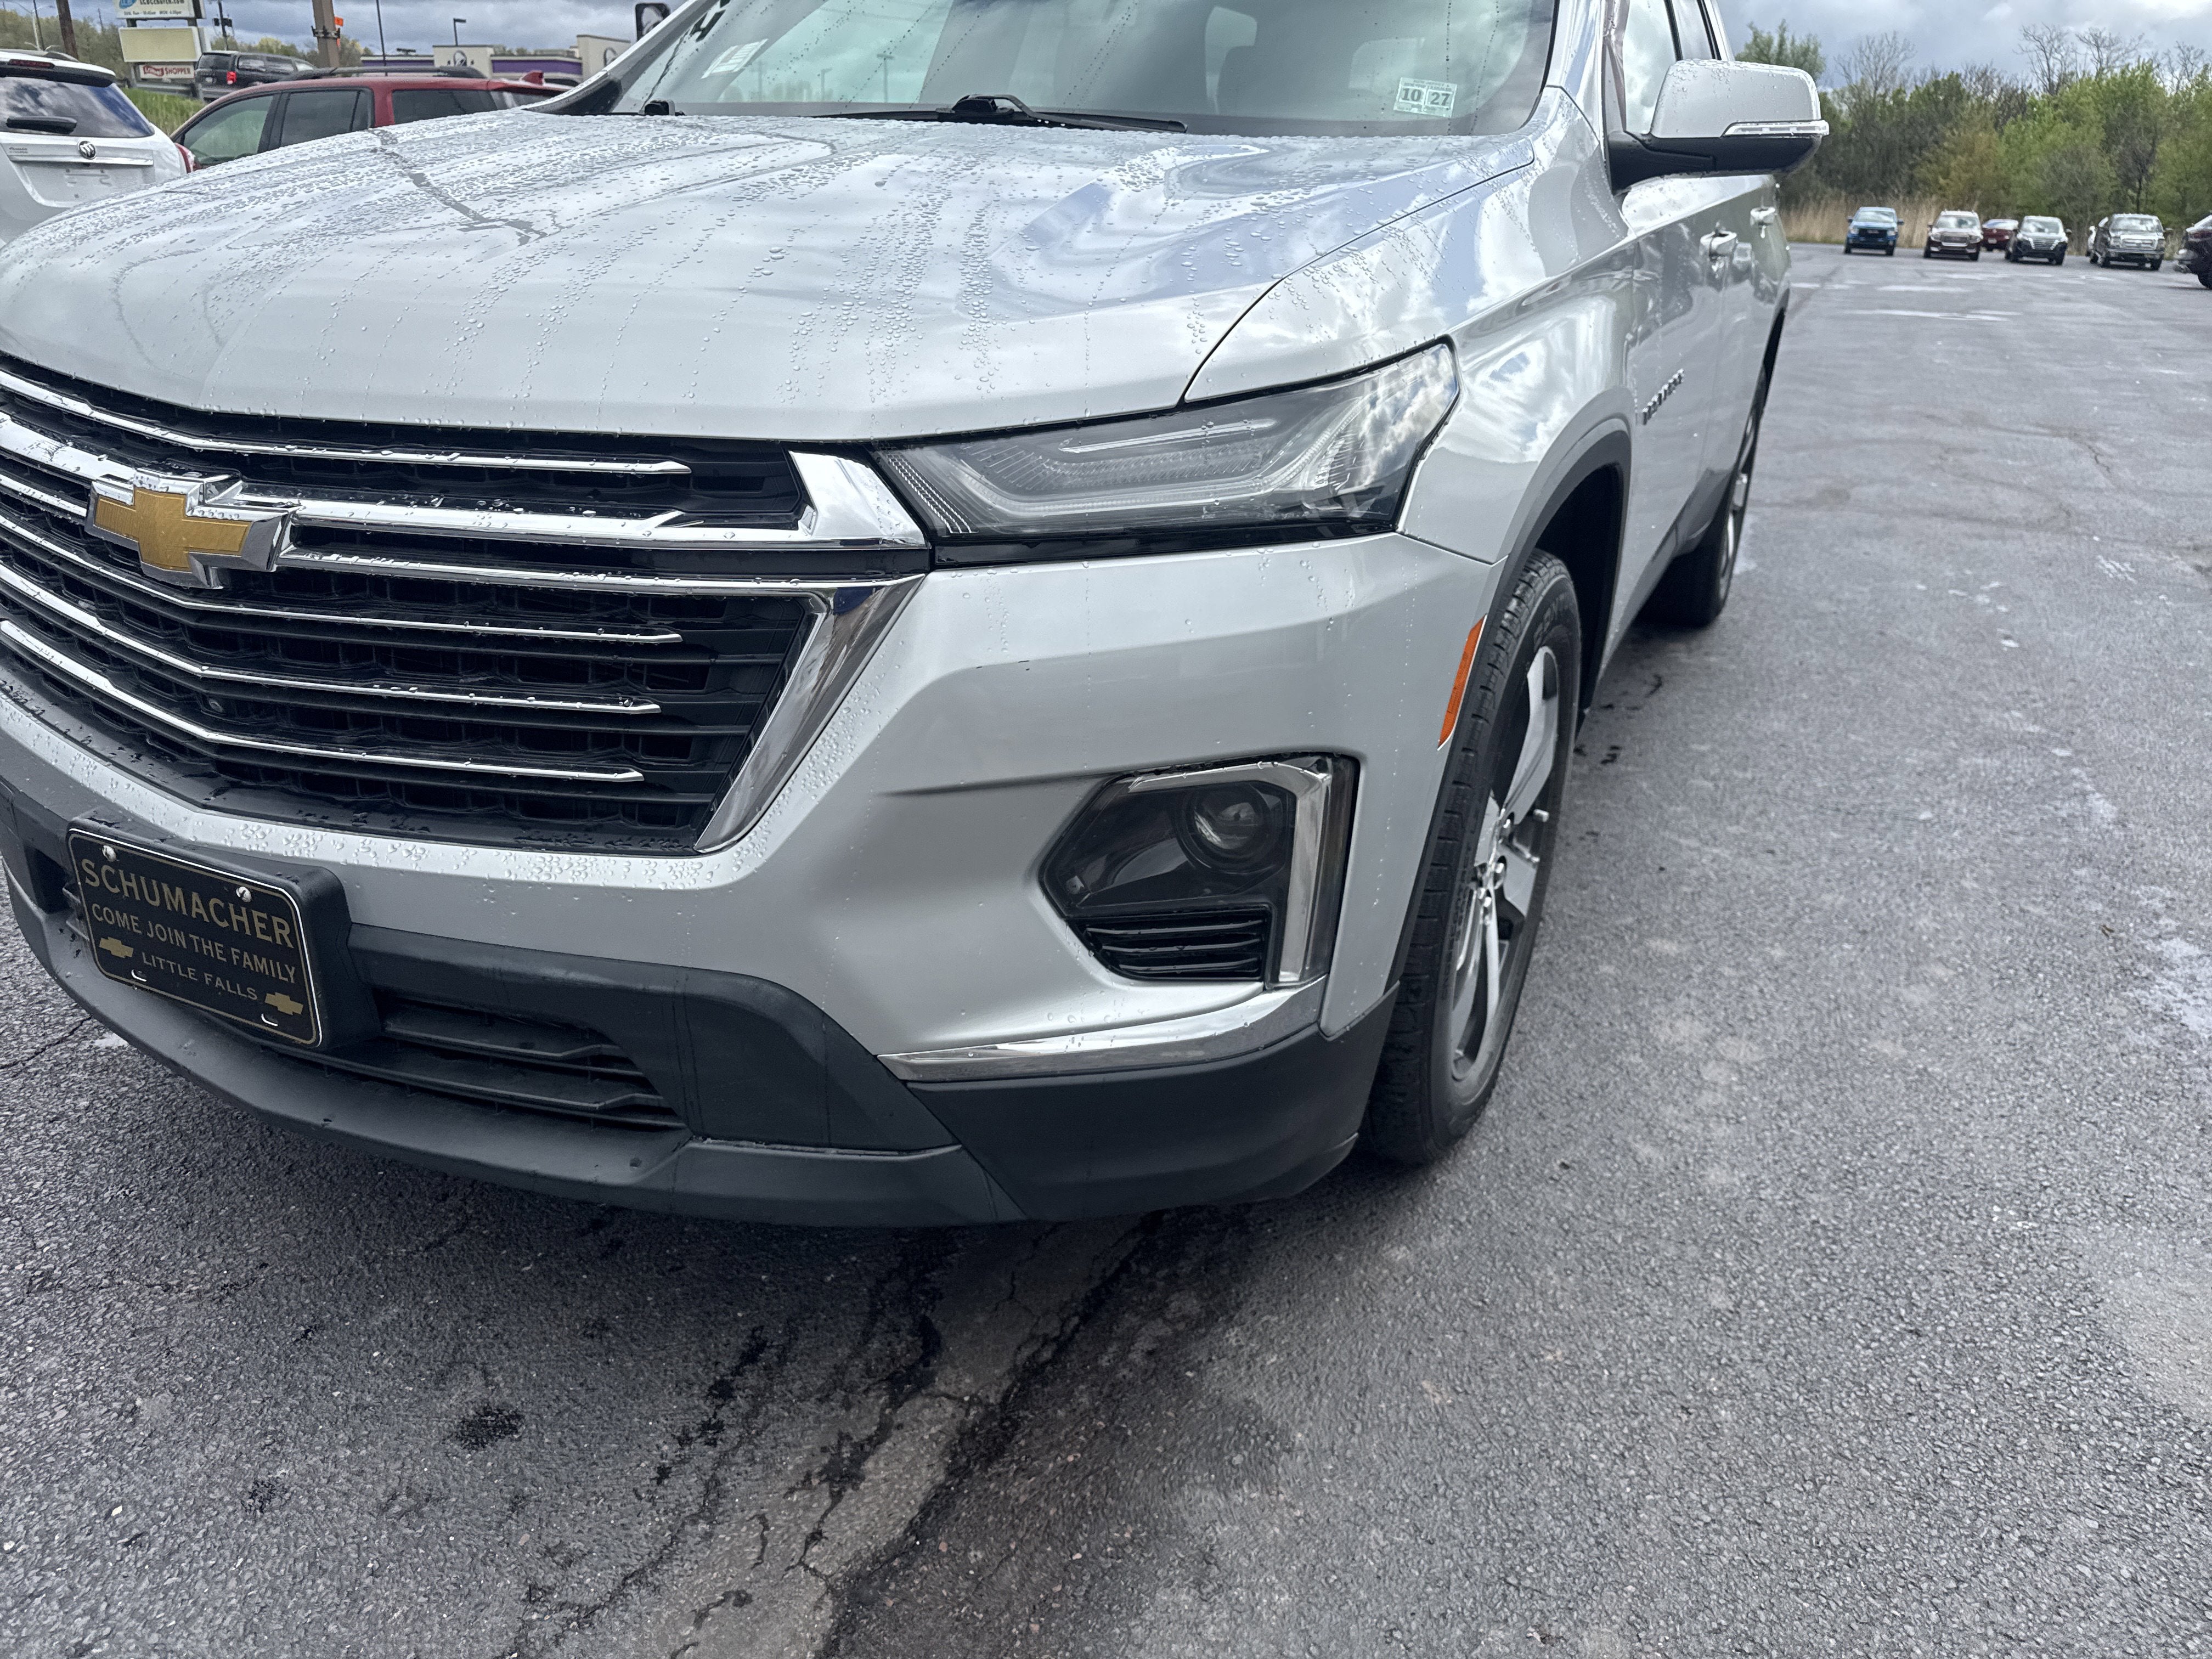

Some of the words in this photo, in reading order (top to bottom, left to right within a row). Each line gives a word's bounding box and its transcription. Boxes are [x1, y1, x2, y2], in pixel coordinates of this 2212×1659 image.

[1401, 88, 1421, 102] 10
[1430, 92, 1451, 106] 27
[81, 858, 295, 949] SCHUMACHER
[92, 903, 142, 934] COME
[146, 921, 187, 950] JOIN
[189, 933, 227, 962] THE
[231, 947, 296, 984] FAMILY
[142, 952, 198, 981] LITTLE
[204, 973, 258, 1001] FALLS
